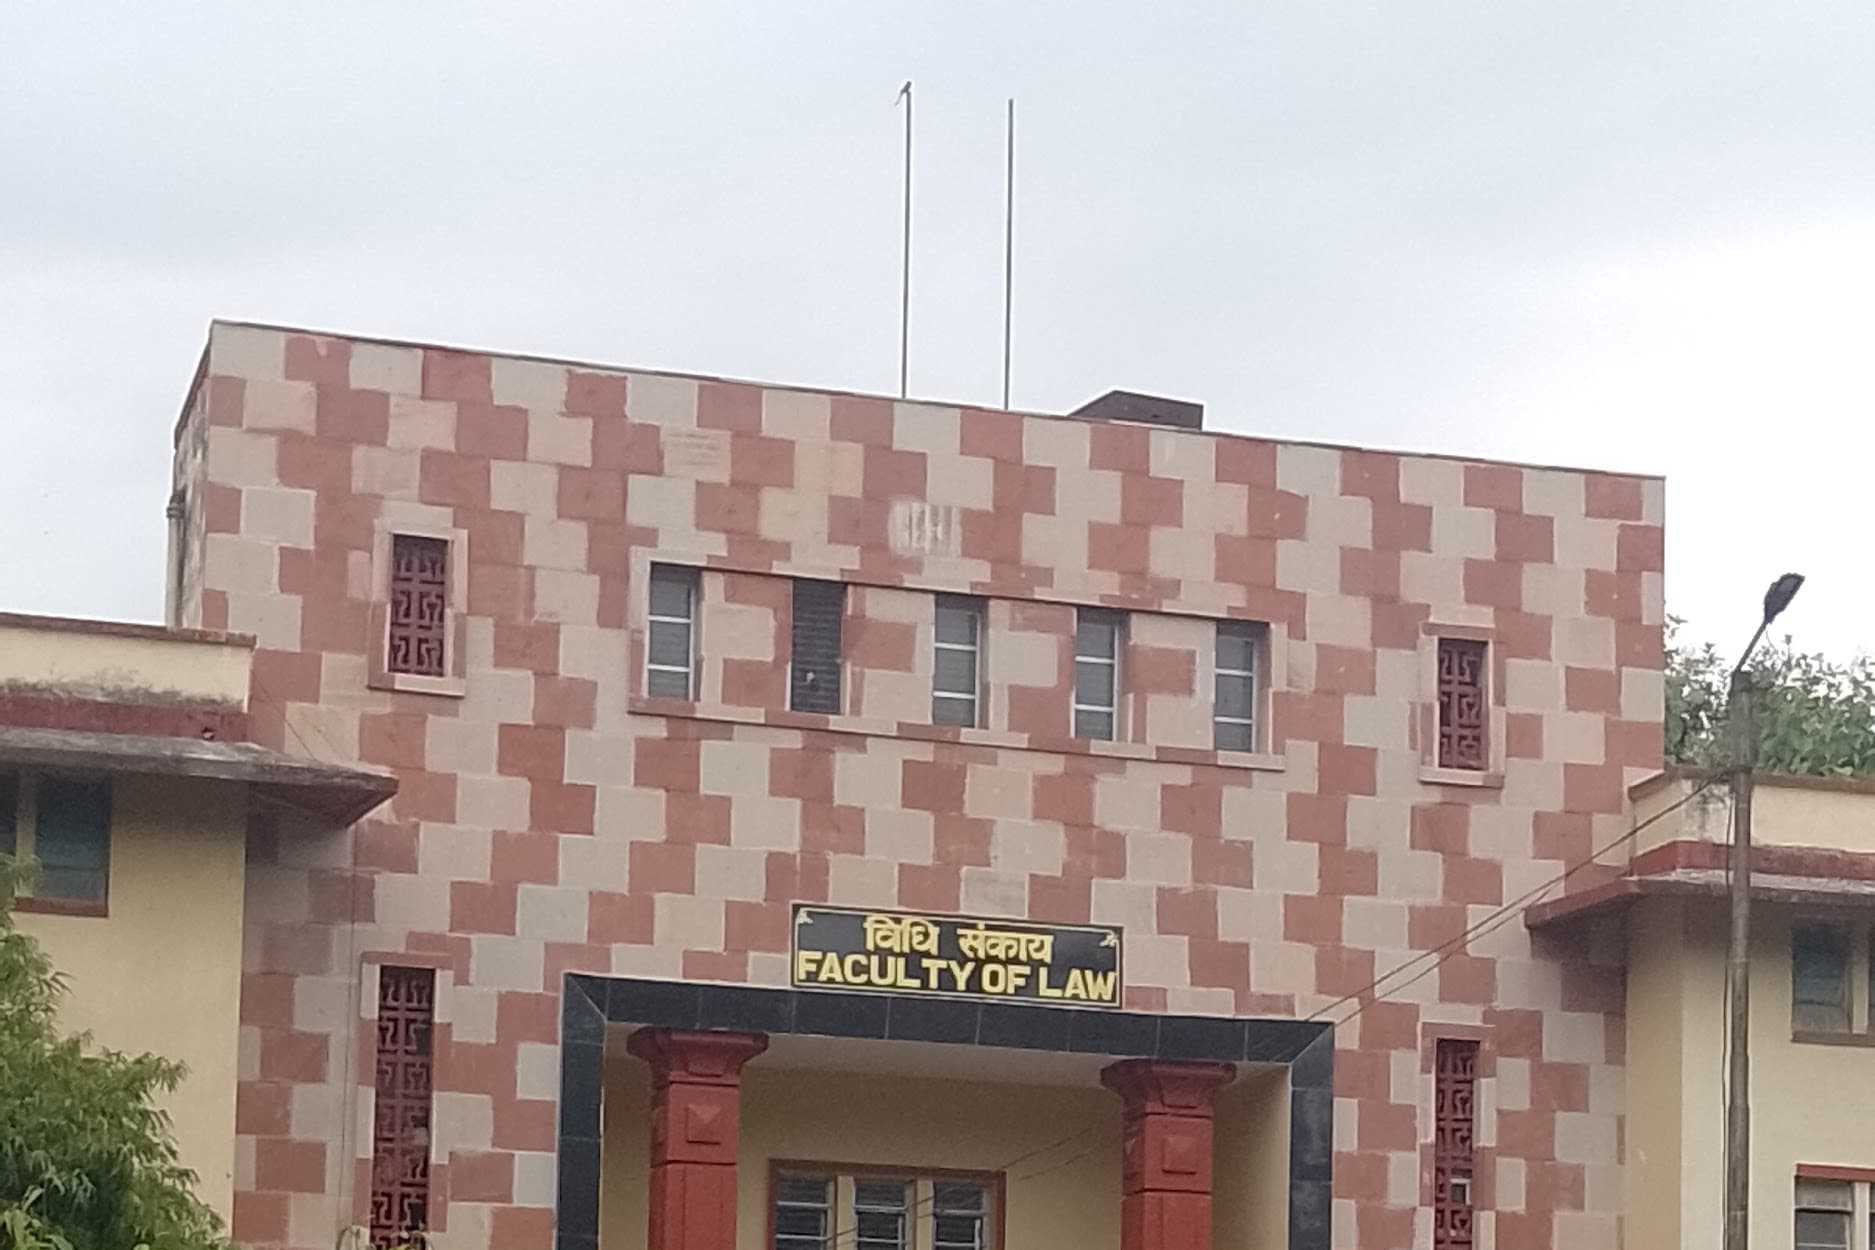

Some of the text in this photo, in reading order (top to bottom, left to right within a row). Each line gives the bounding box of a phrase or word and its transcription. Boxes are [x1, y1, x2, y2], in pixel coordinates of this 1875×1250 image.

[863, 915, 1054, 963] विधि संकाय
[797, 949, 1117, 1001] FACULTY OF LAW
